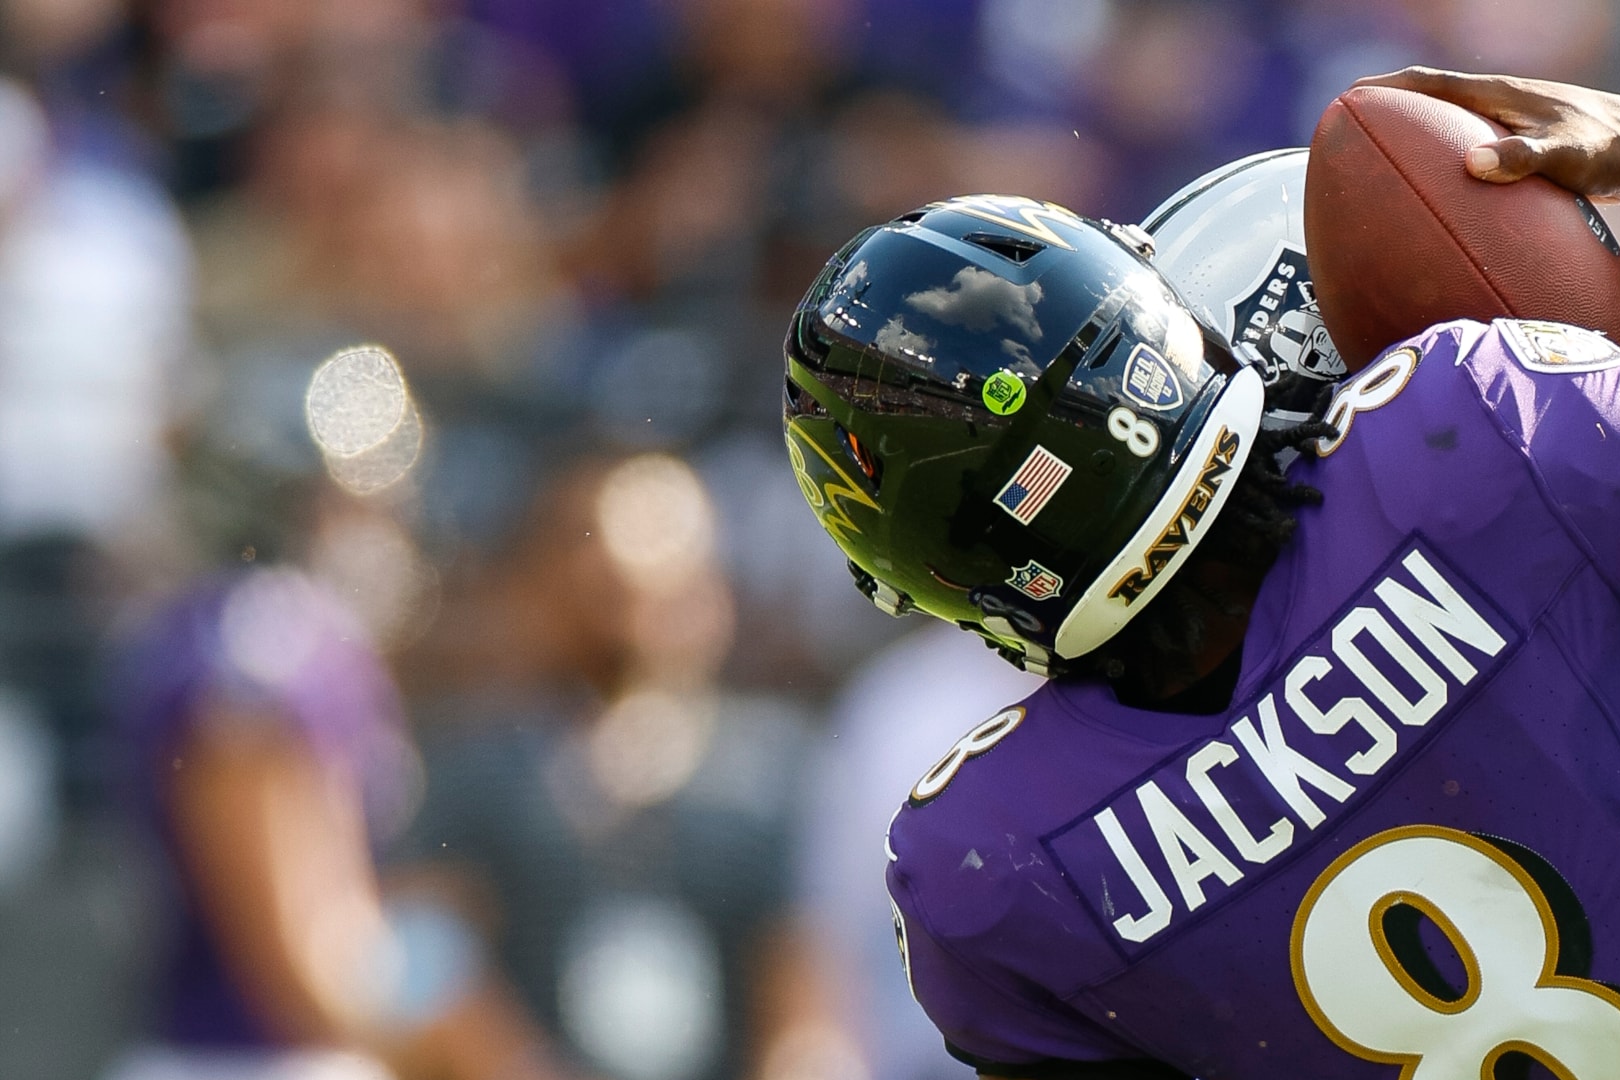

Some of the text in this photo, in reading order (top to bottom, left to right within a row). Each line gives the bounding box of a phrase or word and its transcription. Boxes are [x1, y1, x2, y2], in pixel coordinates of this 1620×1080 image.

[1242, 262, 1297, 341] IDERS
[1129, 366, 1151, 396] JOE
[1315, 343, 1424, 458] 8
[1107, 406, 1161, 458] 8
[1107, 425, 1240, 607] RAVENS
[1024, 574, 1058, 598] NFL
[908, 705, 1026, 807] 8
[1093, 548, 1507, 944] JACKSON
